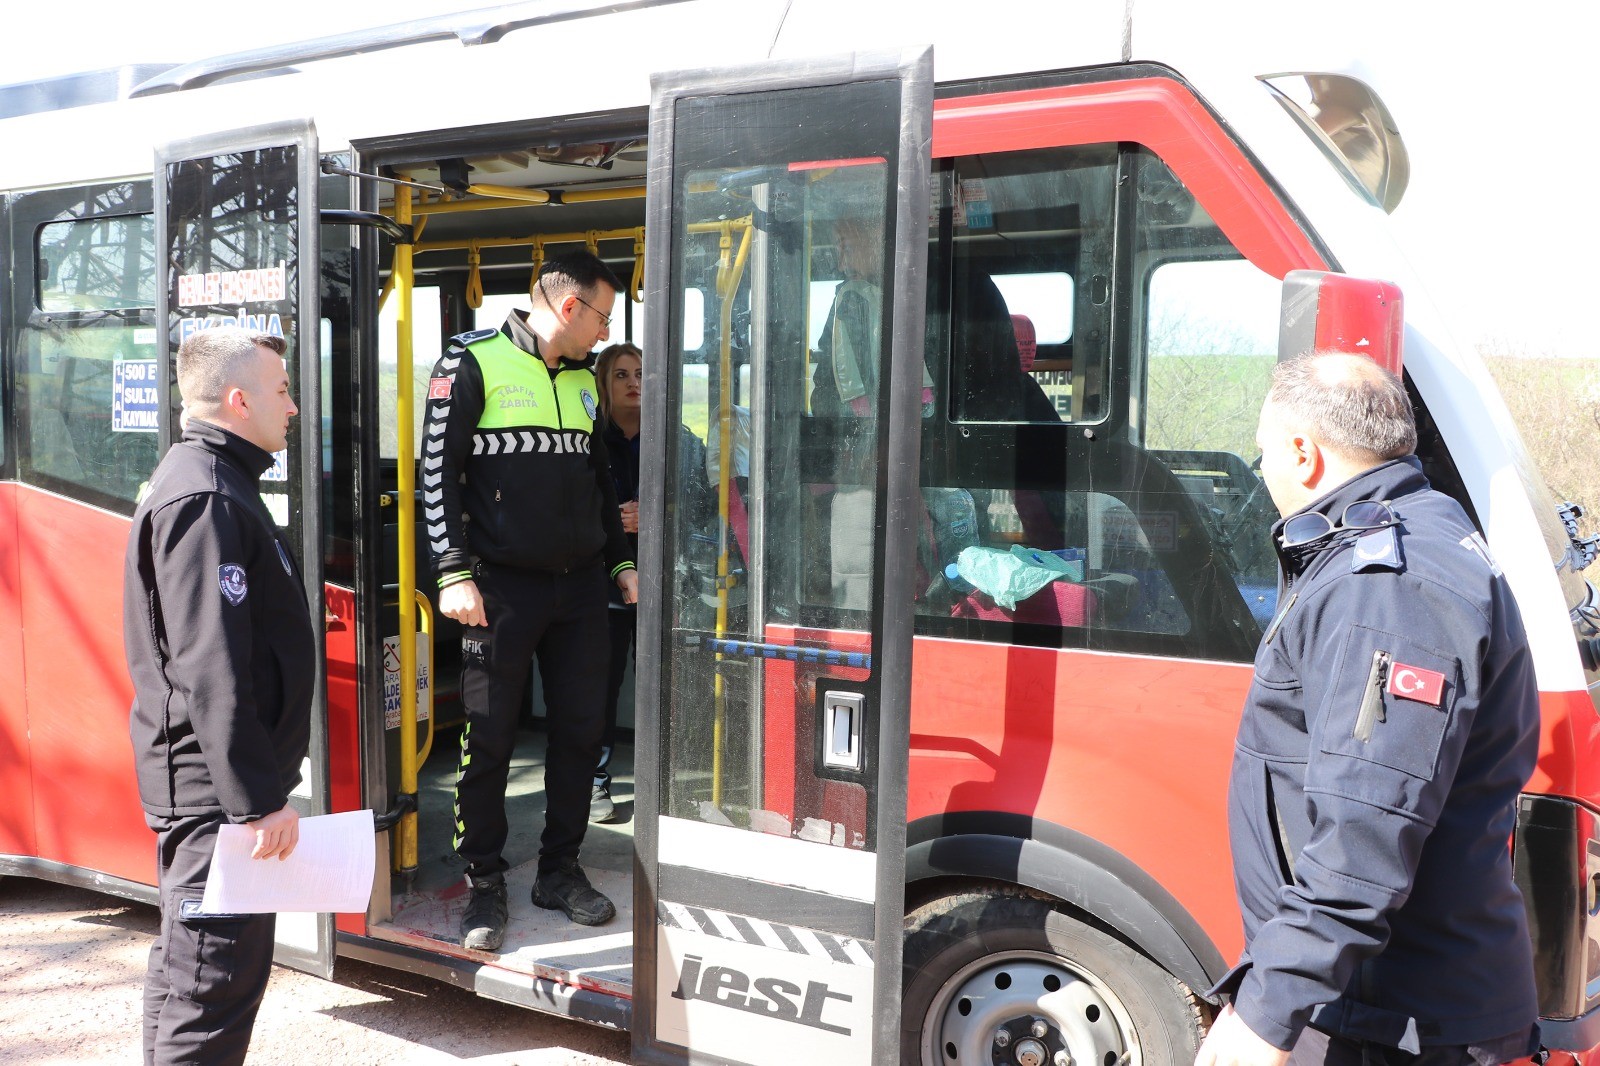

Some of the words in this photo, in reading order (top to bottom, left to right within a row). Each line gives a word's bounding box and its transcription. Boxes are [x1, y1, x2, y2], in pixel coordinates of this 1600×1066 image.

[125, 364, 146, 380] 500
[499, 400, 538, 408] ZABITA
[385, 674, 399, 683] ARA
